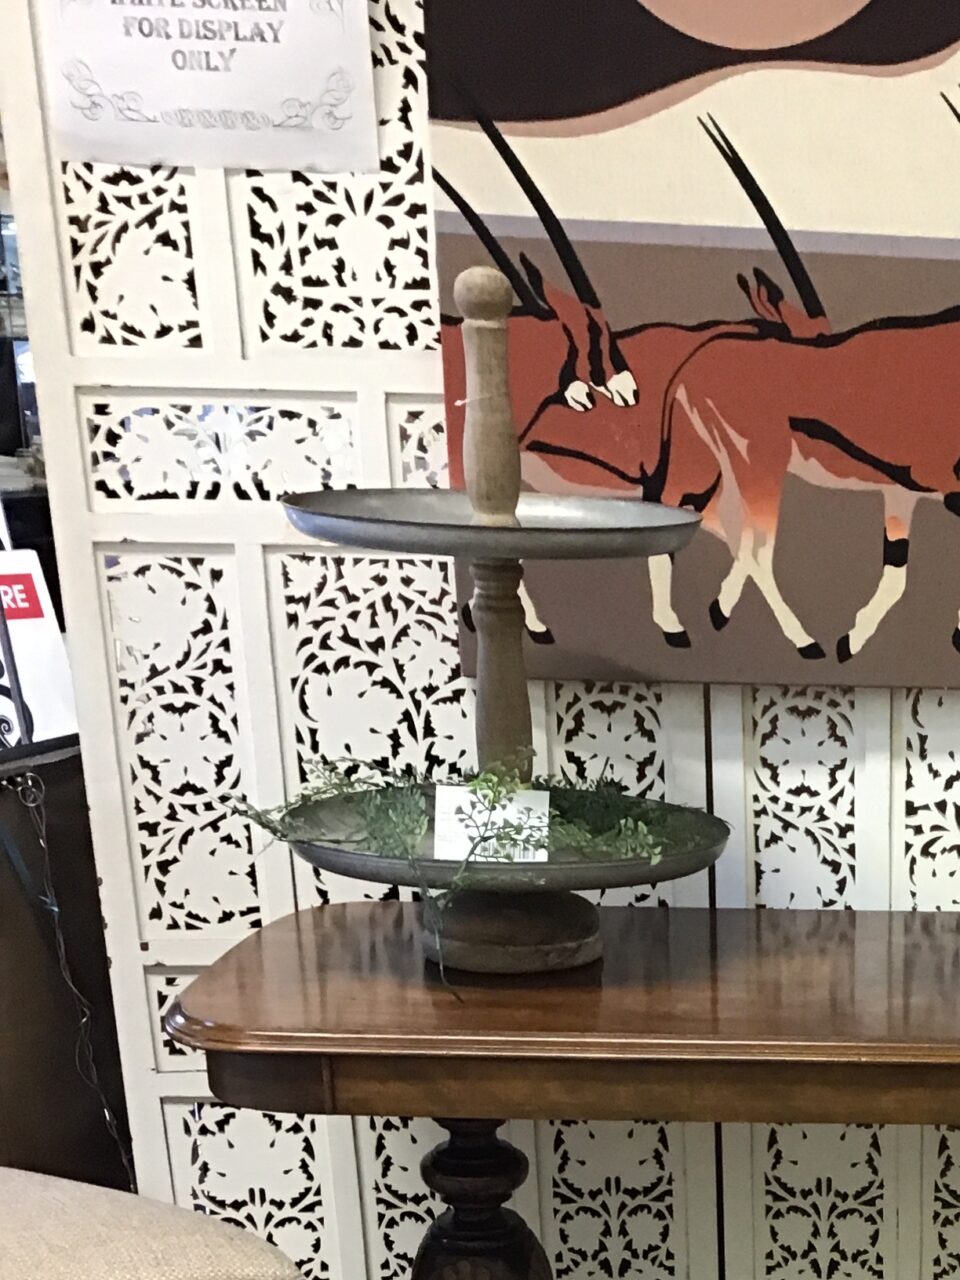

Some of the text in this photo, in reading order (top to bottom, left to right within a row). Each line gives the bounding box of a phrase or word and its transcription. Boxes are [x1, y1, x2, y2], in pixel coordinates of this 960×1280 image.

[123, 16, 285, 43] FOR DISPLAY
[171, 48, 237, 72] ONLY
